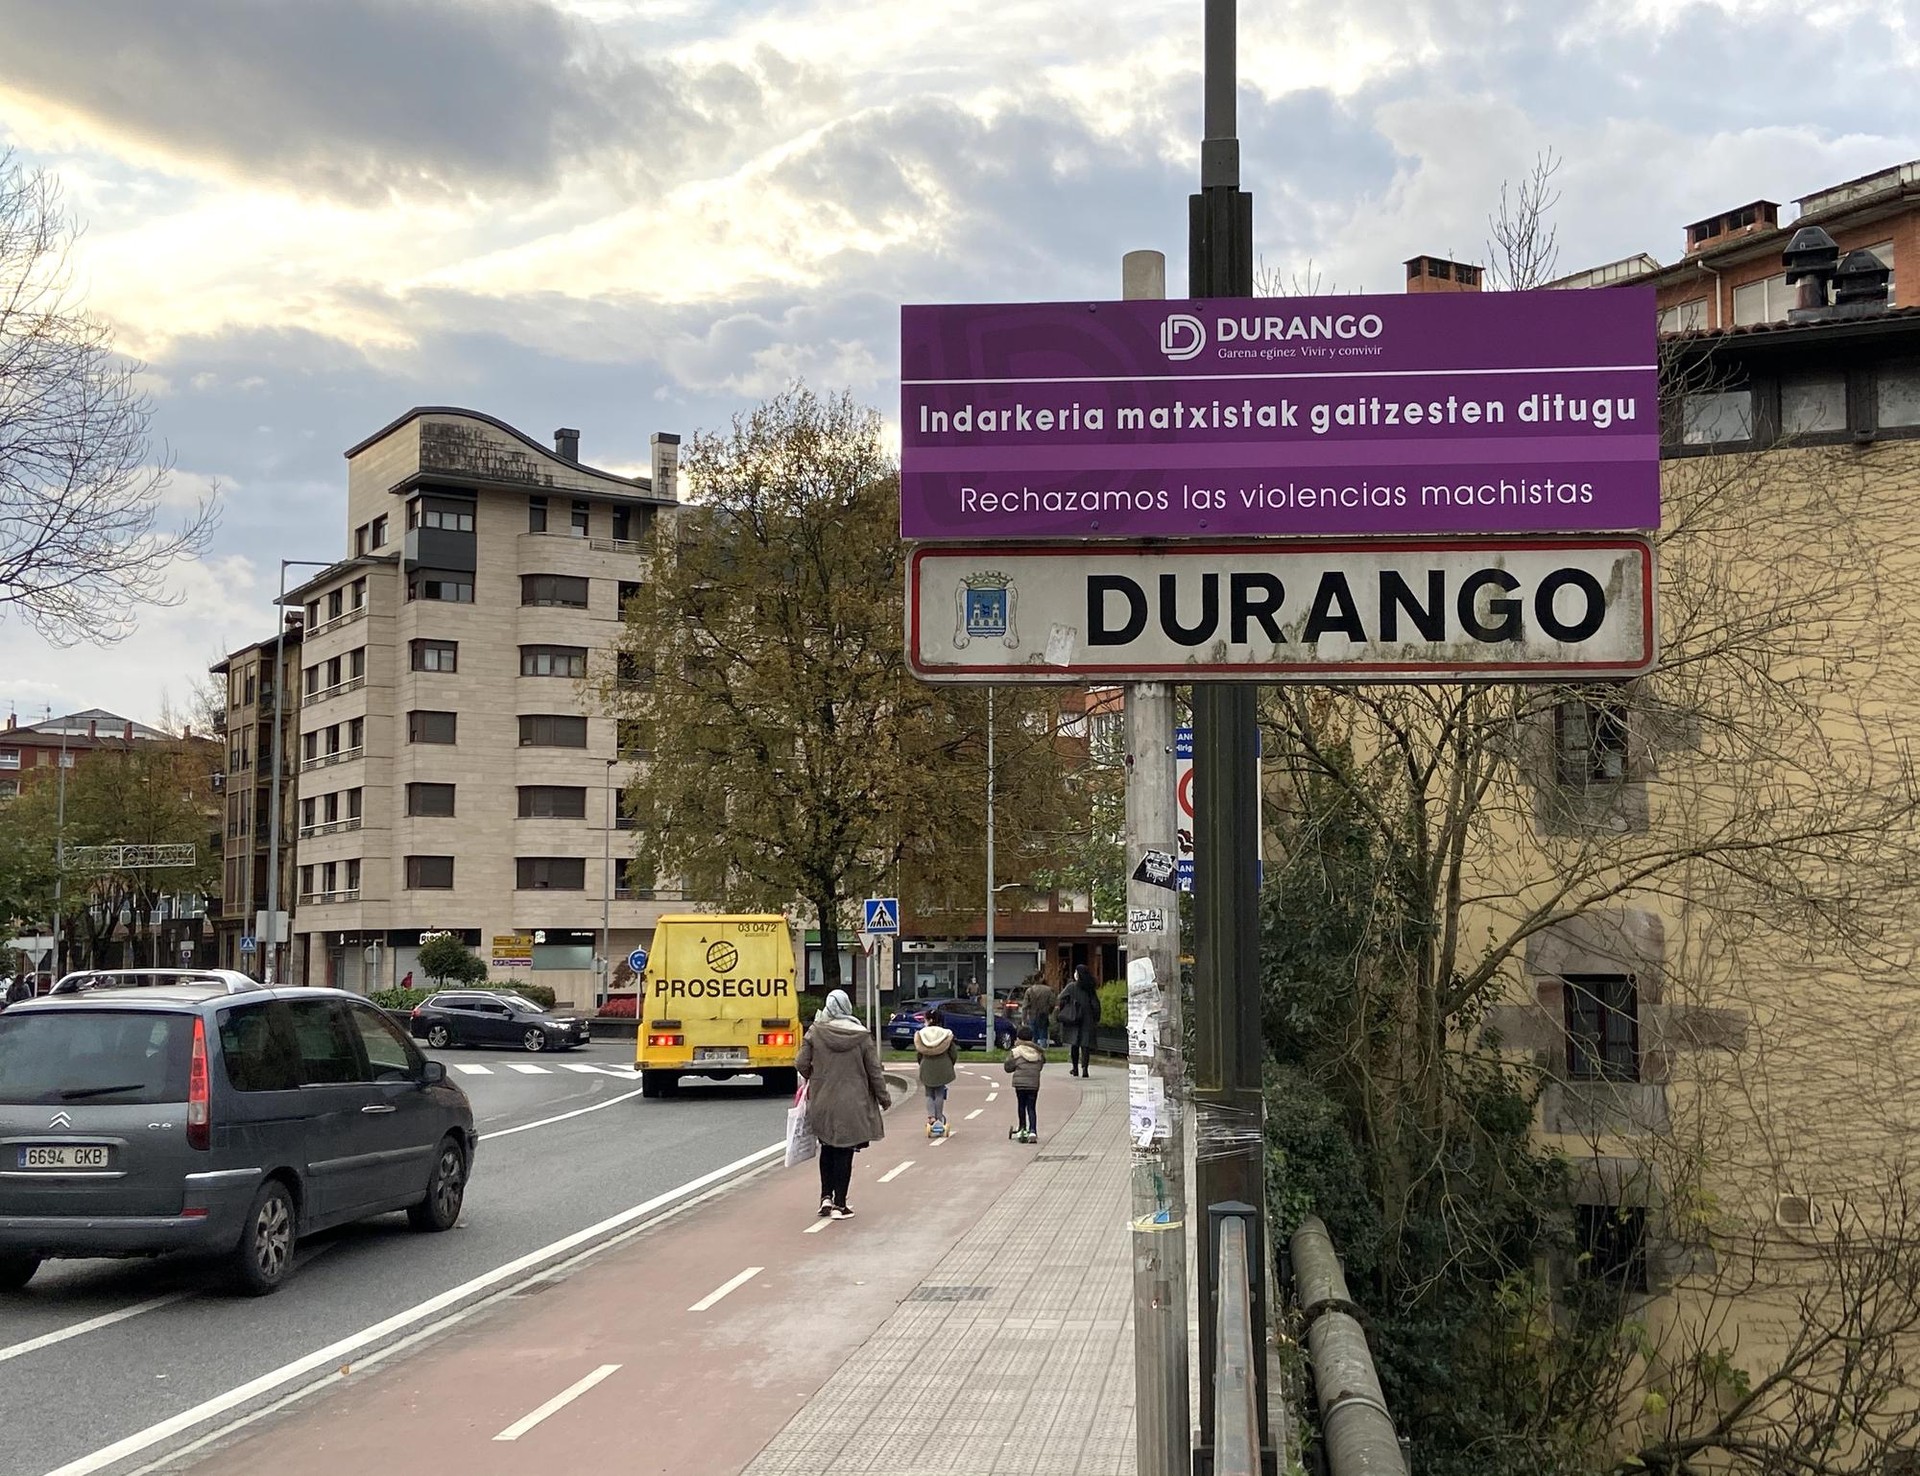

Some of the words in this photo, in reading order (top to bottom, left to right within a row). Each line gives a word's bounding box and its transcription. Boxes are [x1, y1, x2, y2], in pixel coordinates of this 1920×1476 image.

[1217, 314, 1383, 342] DURANGO
[1218, 347, 1257, 359] Garena
[1300, 346, 1326, 358] Vivir
[1329, 348, 1336, 360] y
[1338, 346, 1383, 357] convivir
[919, 402, 1104, 434] Indarkeria
[1117, 399, 1298, 430] matxistak
[1310, 396, 1504, 434] gaitzesten
[1517, 393, 1637, 429] ditugu
[960, 486, 1169, 513] Rechazamos
[1183, 484, 1226, 510] las
[1239, 481, 1407, 509] violencias
[1421, 478, 1593, 506] machistas
[1087, 568, 1606, 647] DURANGO
[738, 922, 750, 933] 03
[752, 922, 777, 933] 0472
[655, 978, 788, 998] PROSEGUR
[28, 1148, 65, 1165] 6694
[74, 1148, 103, 1165] GKB
